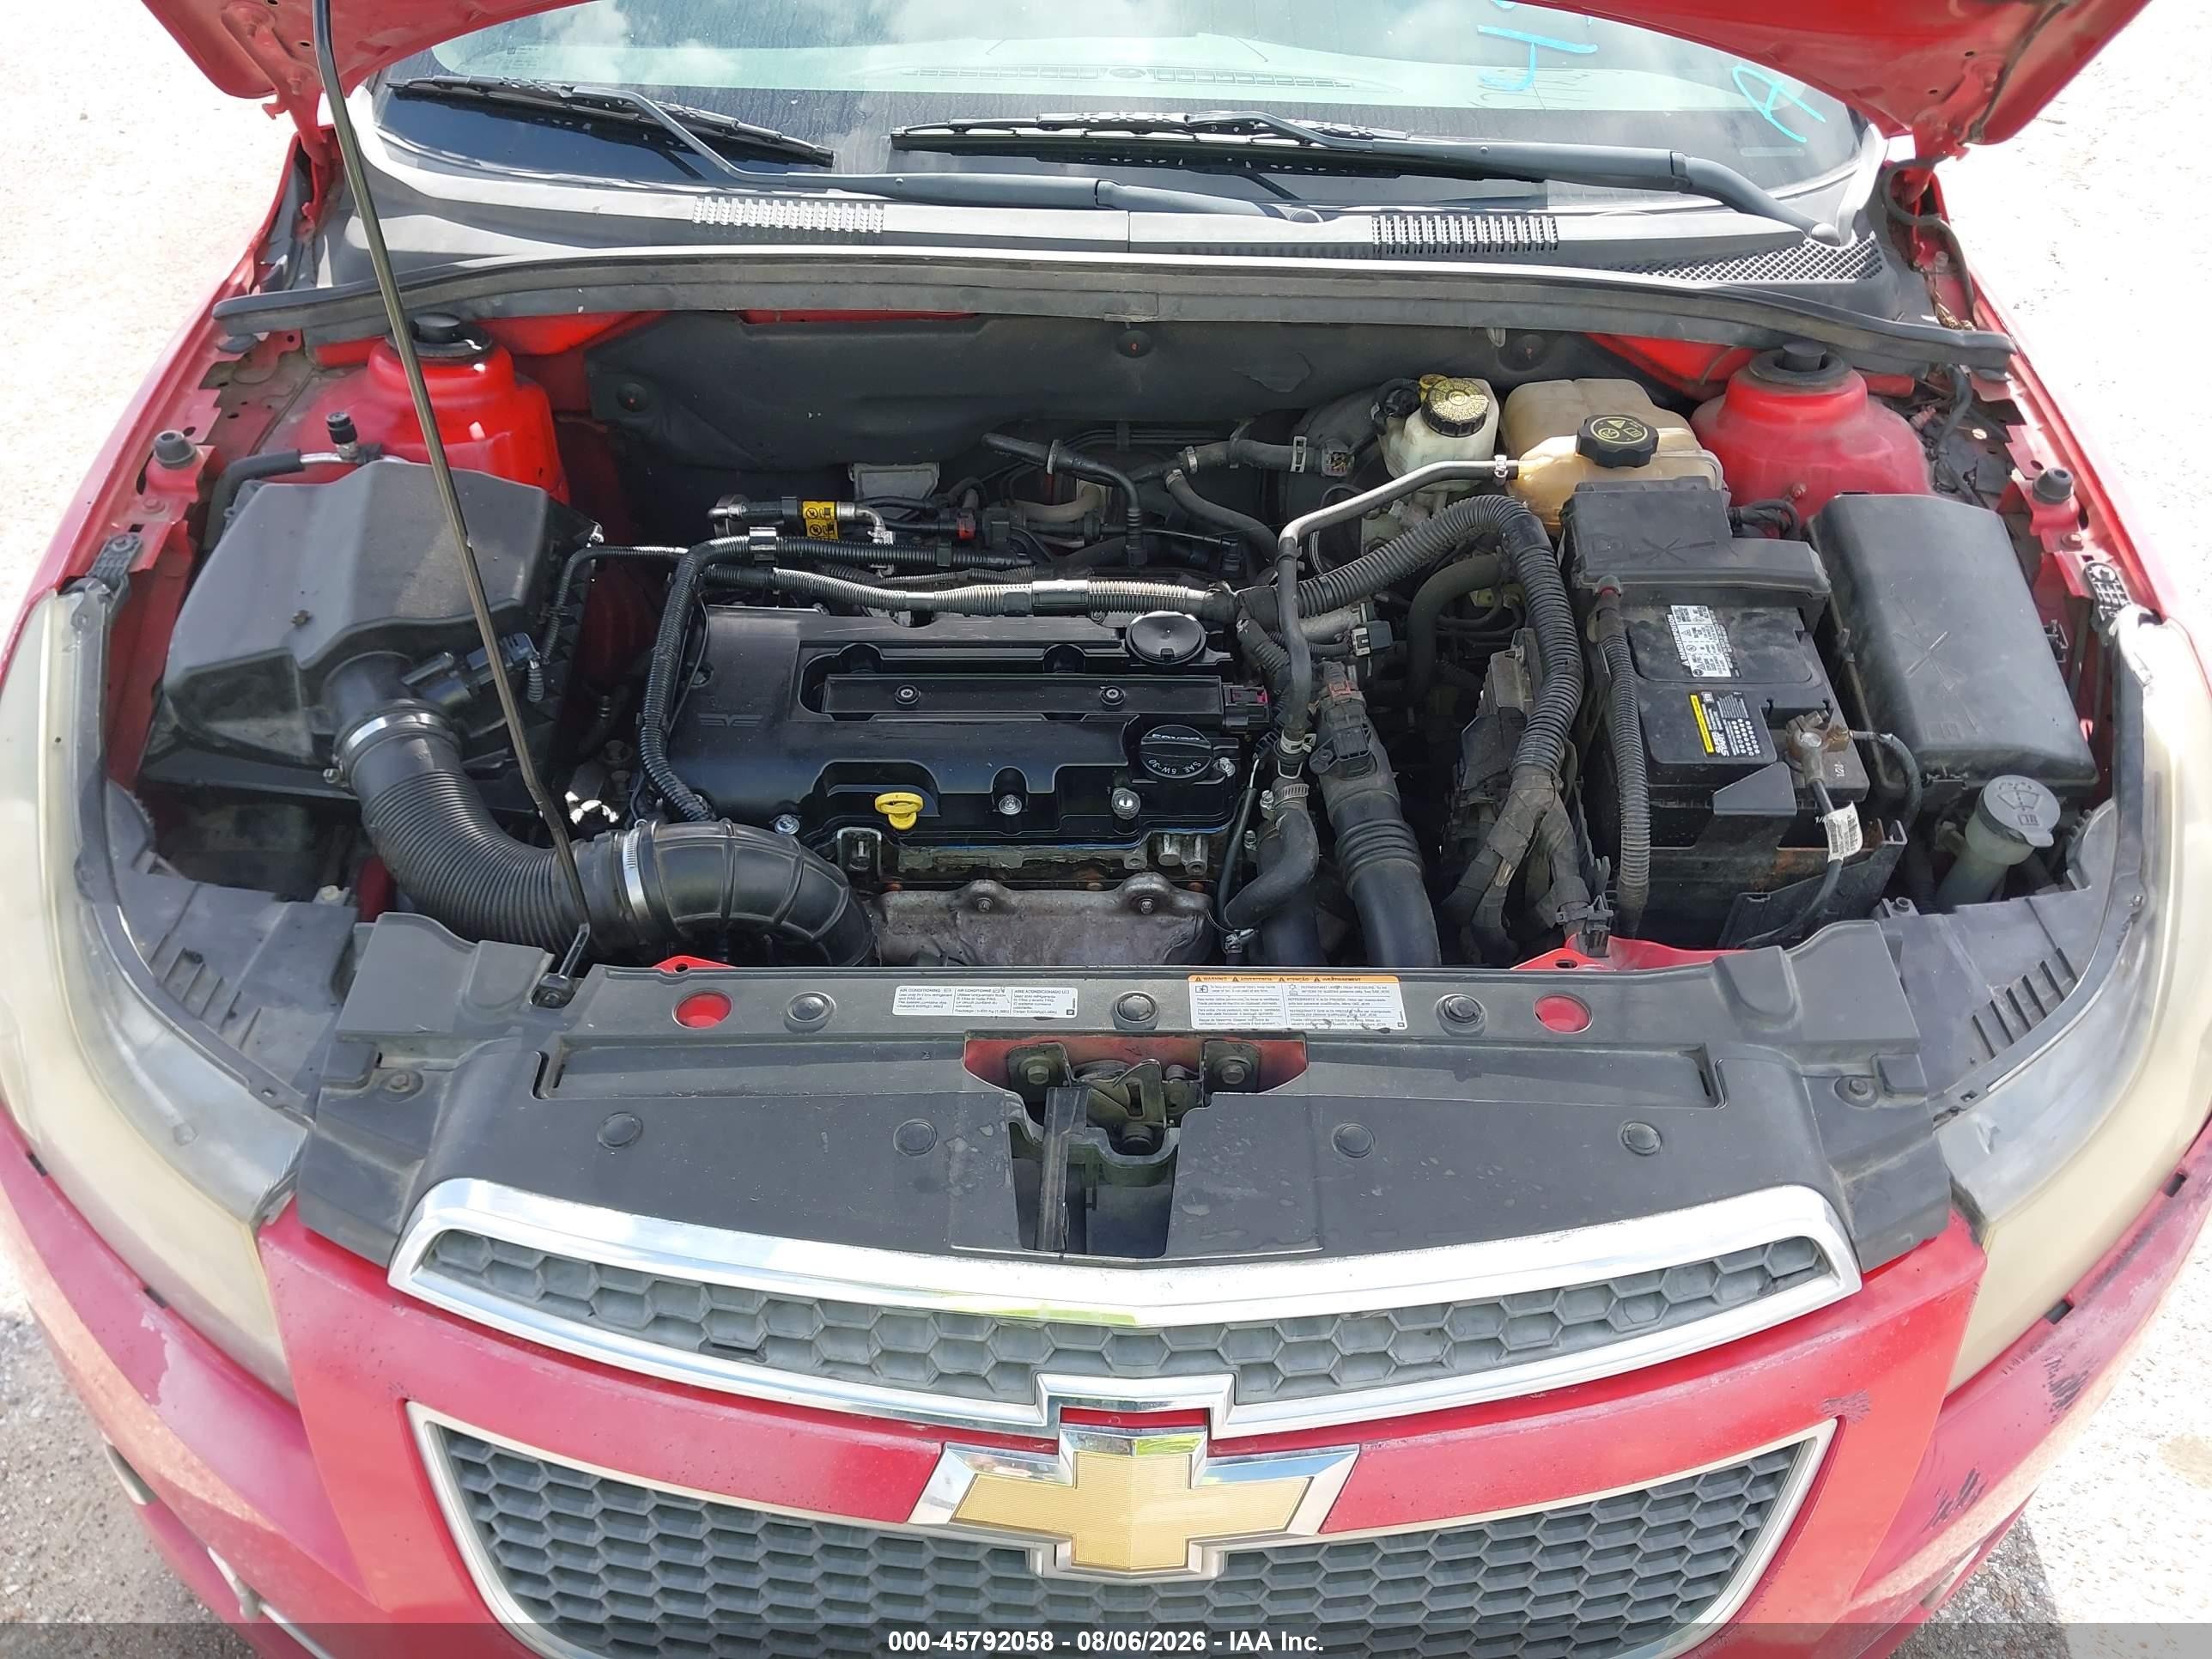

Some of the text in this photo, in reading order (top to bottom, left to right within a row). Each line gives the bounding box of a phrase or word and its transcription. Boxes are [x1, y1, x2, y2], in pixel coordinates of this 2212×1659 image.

[1731, 64, 1827, 143] A
[1148, 759, 1201, 775] SAE 5W-30
